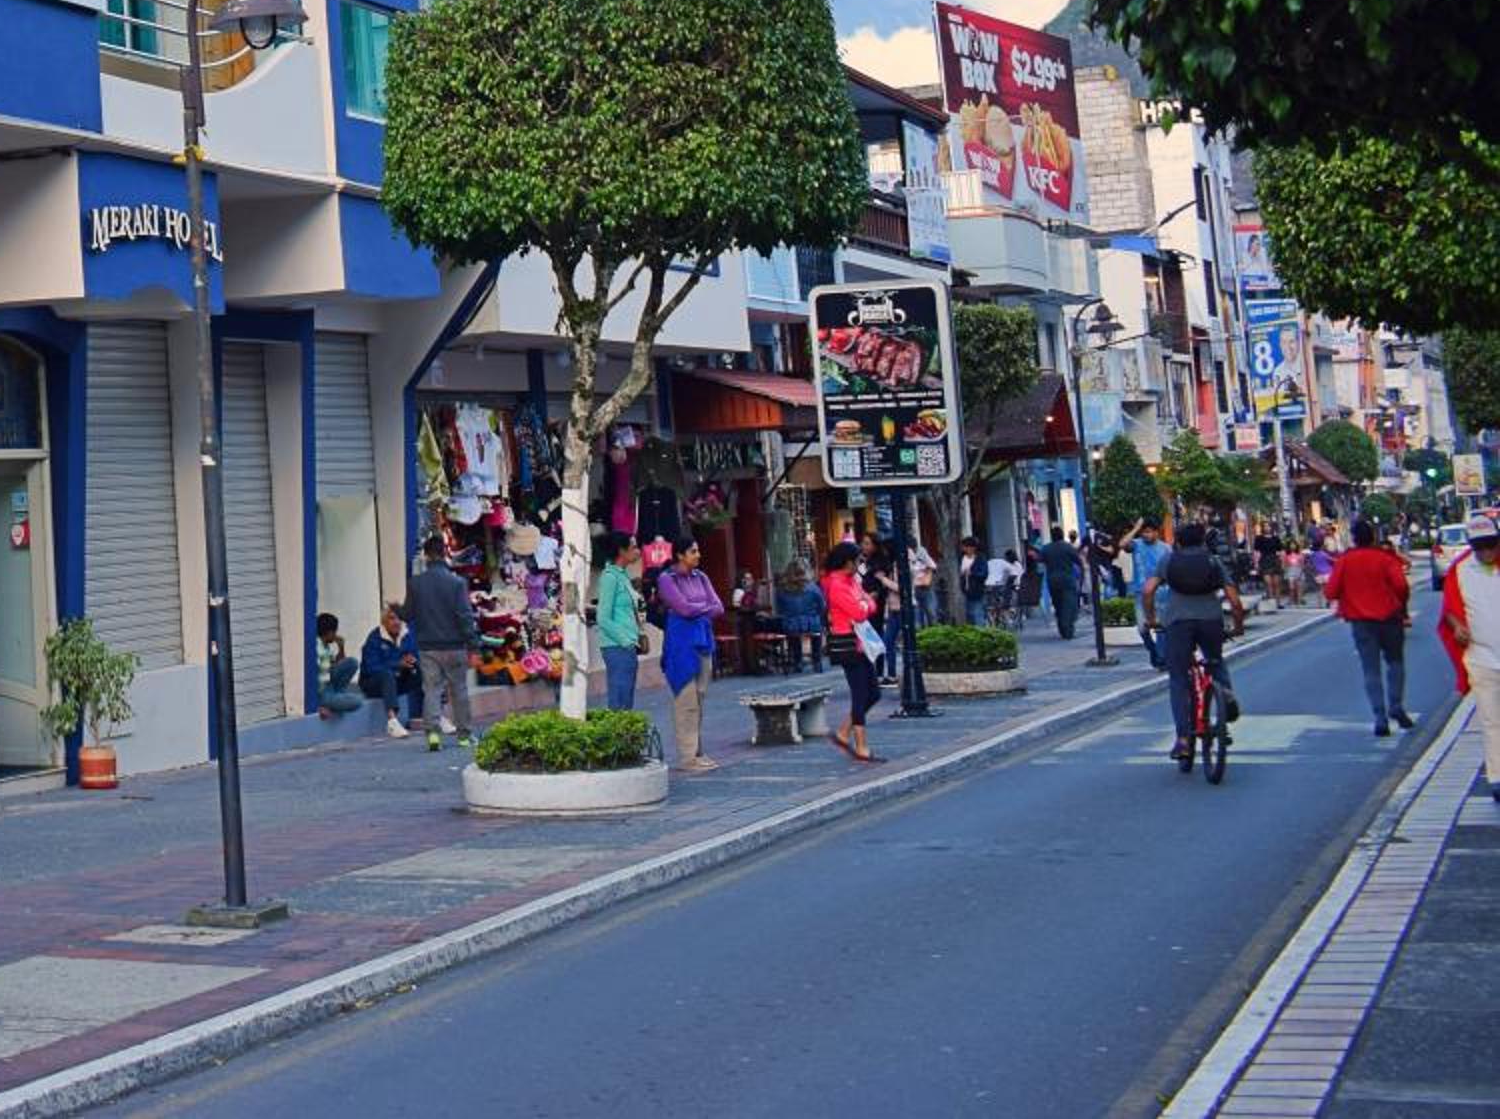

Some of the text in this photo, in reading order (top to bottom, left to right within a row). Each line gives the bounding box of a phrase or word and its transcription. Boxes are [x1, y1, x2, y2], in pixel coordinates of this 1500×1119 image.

[961, 58, 998, 94] BOX
[1028, 166, 1061, 194] KFC
[91, 203, 223, 263] MERAKI HOEL
[1253, 340, 1275, 376] 8
